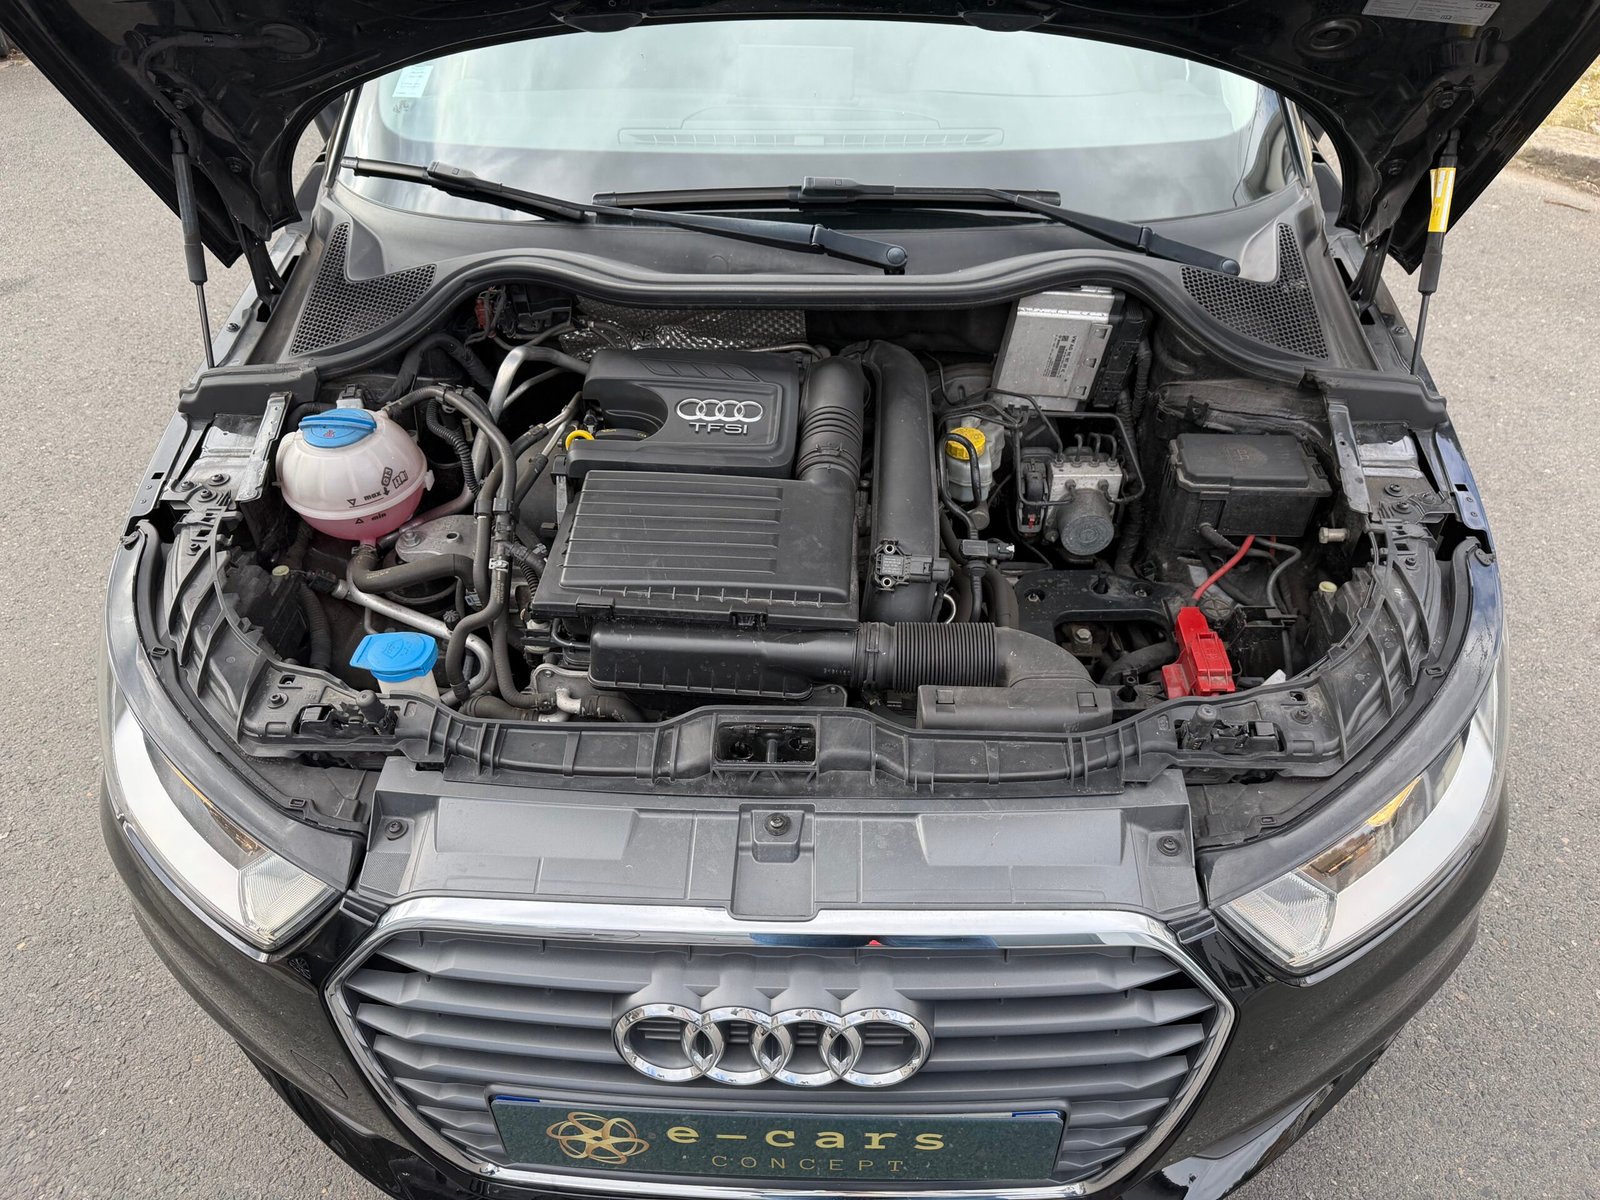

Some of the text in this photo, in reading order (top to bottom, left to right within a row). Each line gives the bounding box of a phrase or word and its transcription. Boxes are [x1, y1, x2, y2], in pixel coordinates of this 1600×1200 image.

[689, 422, 748, 435] TFSI
[363, 491, 382, 501] max
[371, 512, 387, 521] min
[711, 1155, 904, 1173] CONCEPT
